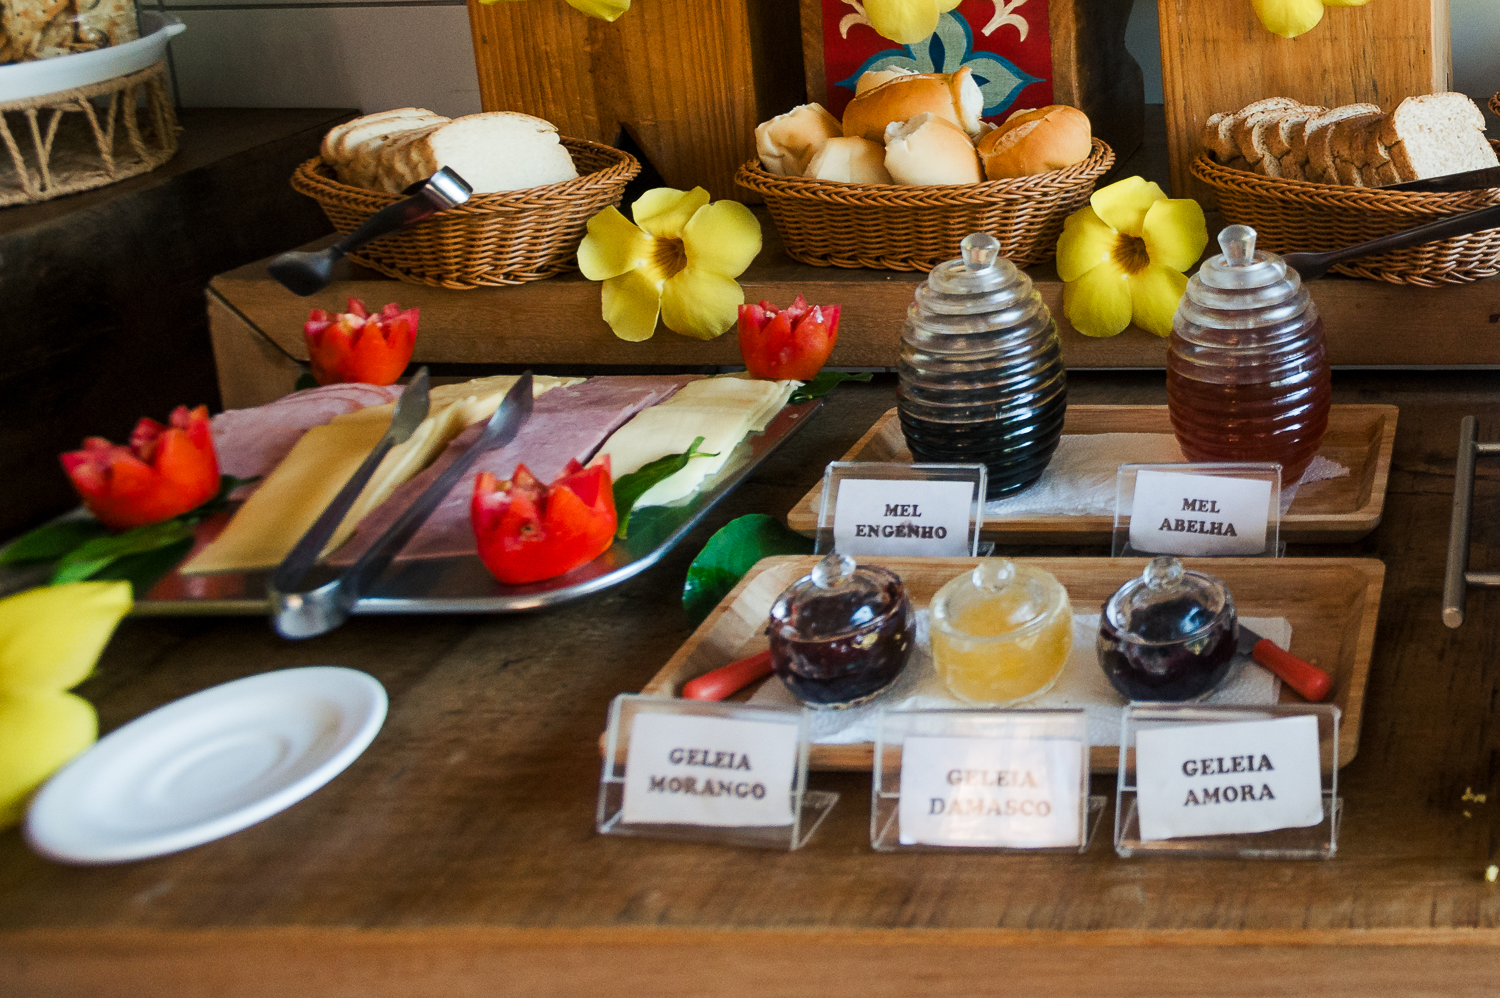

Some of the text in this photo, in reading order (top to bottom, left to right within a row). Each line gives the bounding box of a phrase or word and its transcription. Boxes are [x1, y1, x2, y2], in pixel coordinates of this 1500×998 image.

[883, 503, 923, 518] MEL
[1181, 497, 1221, 515] MEL
[854, 524, 948, 540] ENGENHO
[1158, 517, 1238, 538] ABELHA
[668, 748, 752, 772] GELEIA
[1181, 754, 1275, 778] GELEIA
[648, 775, 768, 800] MORANGO
[945, 768, 1039, 789] GELEIA
[1183, 782, 1276, 807] AMORA
[928, 796, 1052, 819] DAMASCO
